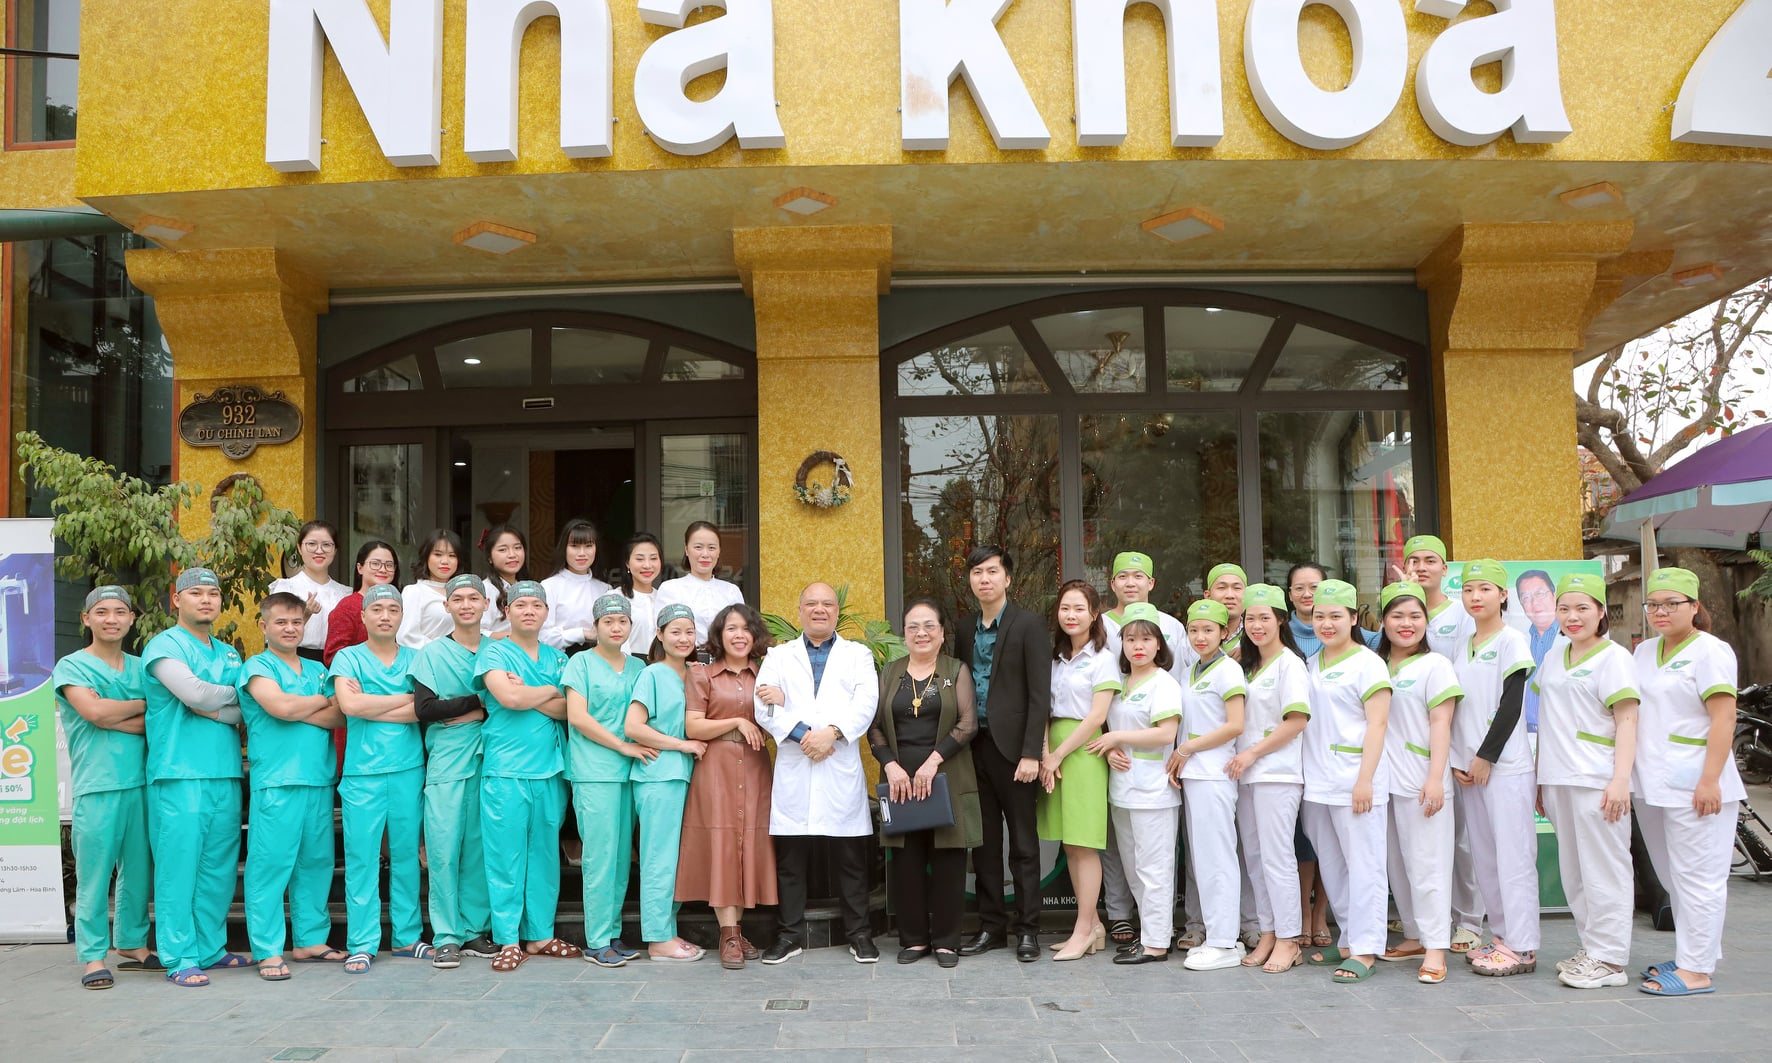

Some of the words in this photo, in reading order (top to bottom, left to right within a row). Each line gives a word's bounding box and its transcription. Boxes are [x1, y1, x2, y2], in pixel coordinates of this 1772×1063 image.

[900, 0, 1572, 152] khoa
[222, 405, 256, 426] 932
[217, 424, 254, 439] CHÍNH
[258, 426, 282, 438] LAN
[5, 784, 24, 793] 50%
[1043, 897, 1059, 905] NHA
[1061, 896, 1077, 904] KHO
